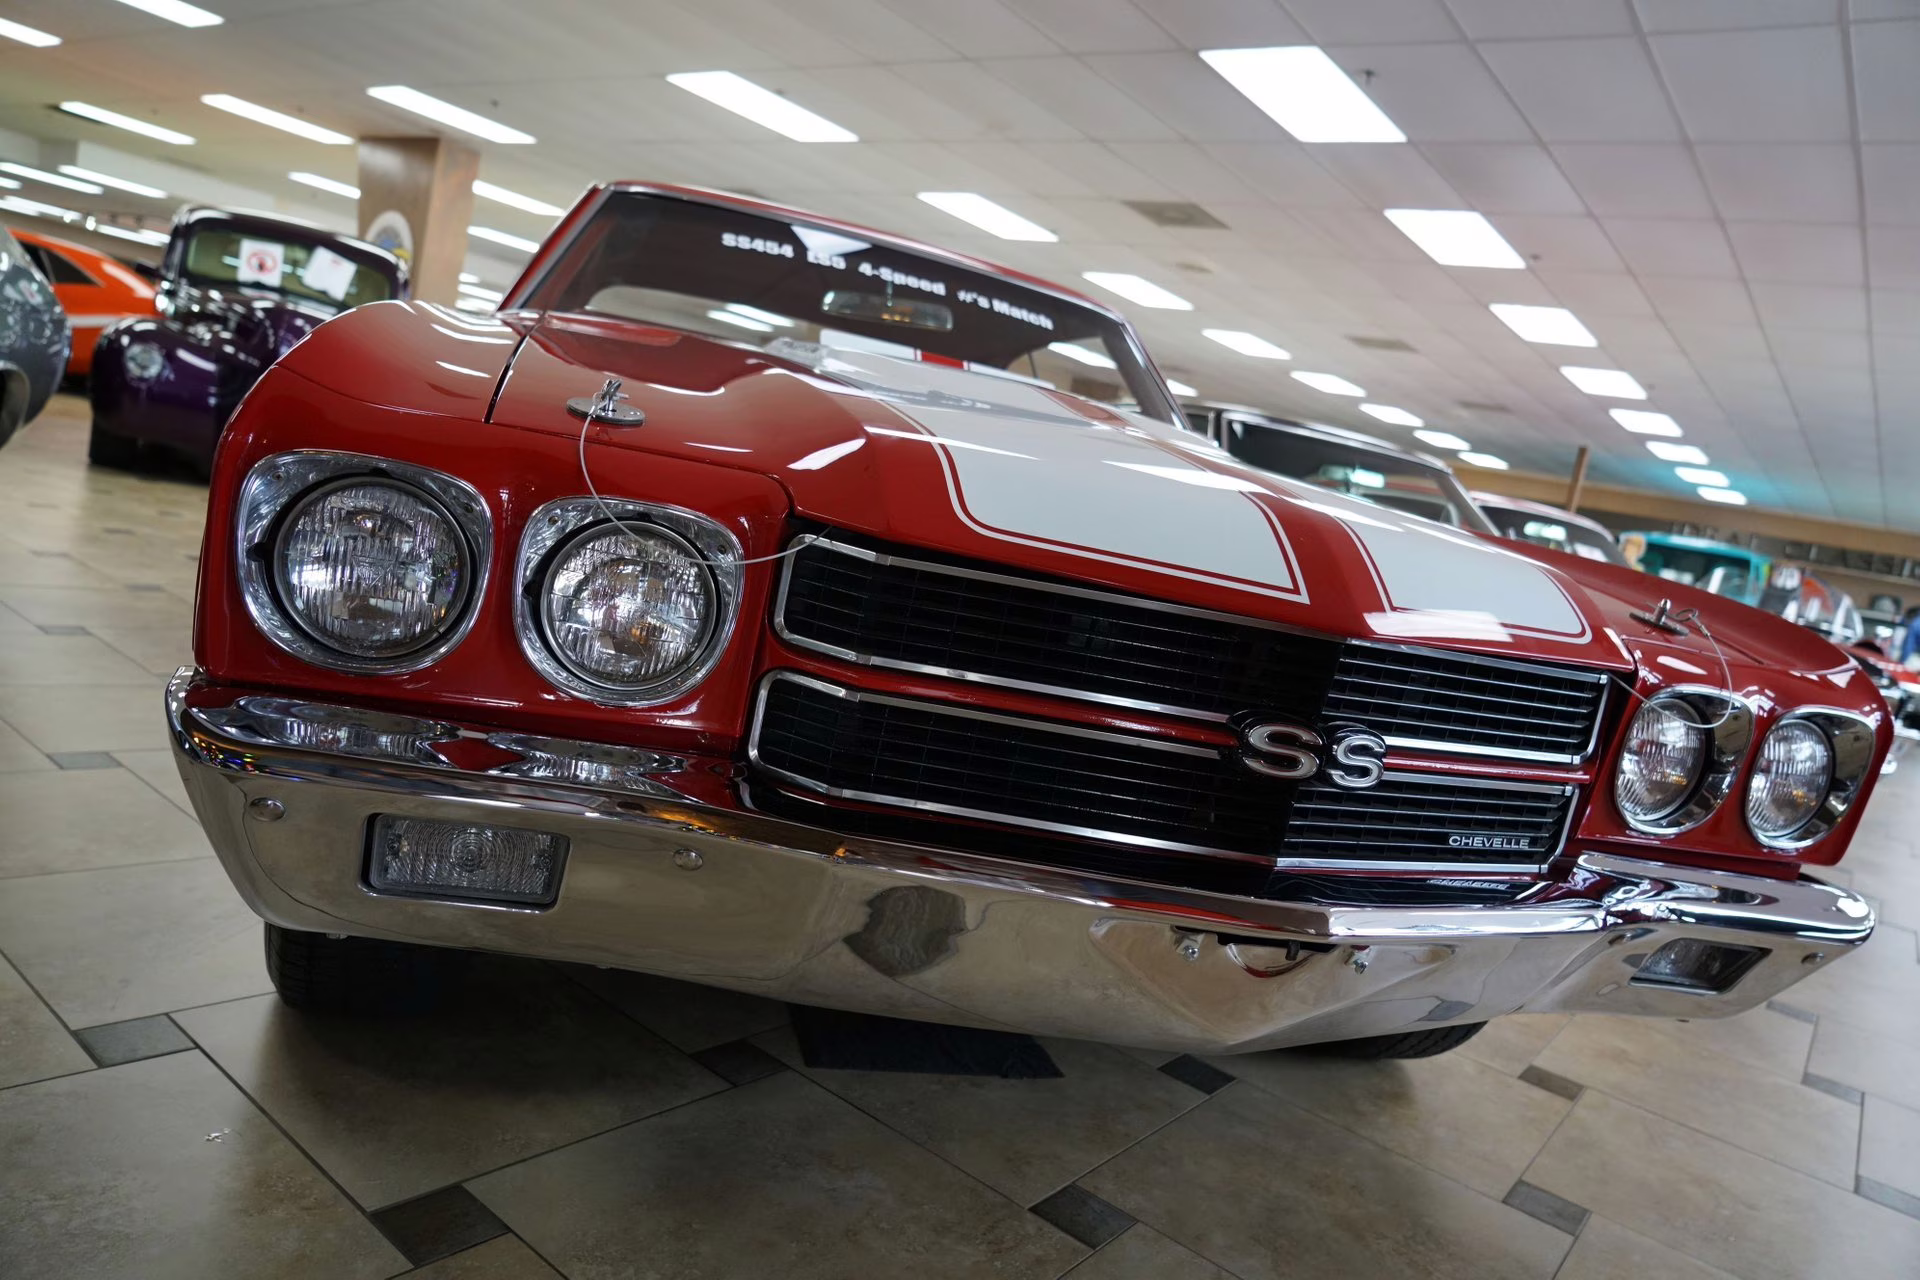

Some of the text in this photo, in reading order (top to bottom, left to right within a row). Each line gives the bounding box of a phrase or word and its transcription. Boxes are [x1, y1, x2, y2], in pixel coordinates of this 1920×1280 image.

[721, 231, 795, 259] SS454
[857, 261, 947, 297] 4-Speed
[991, 298, 1055, 331] Match
[1241, 721, 1387, 789] SS
[1448, 835, 1531, 849] CHEVELLE
